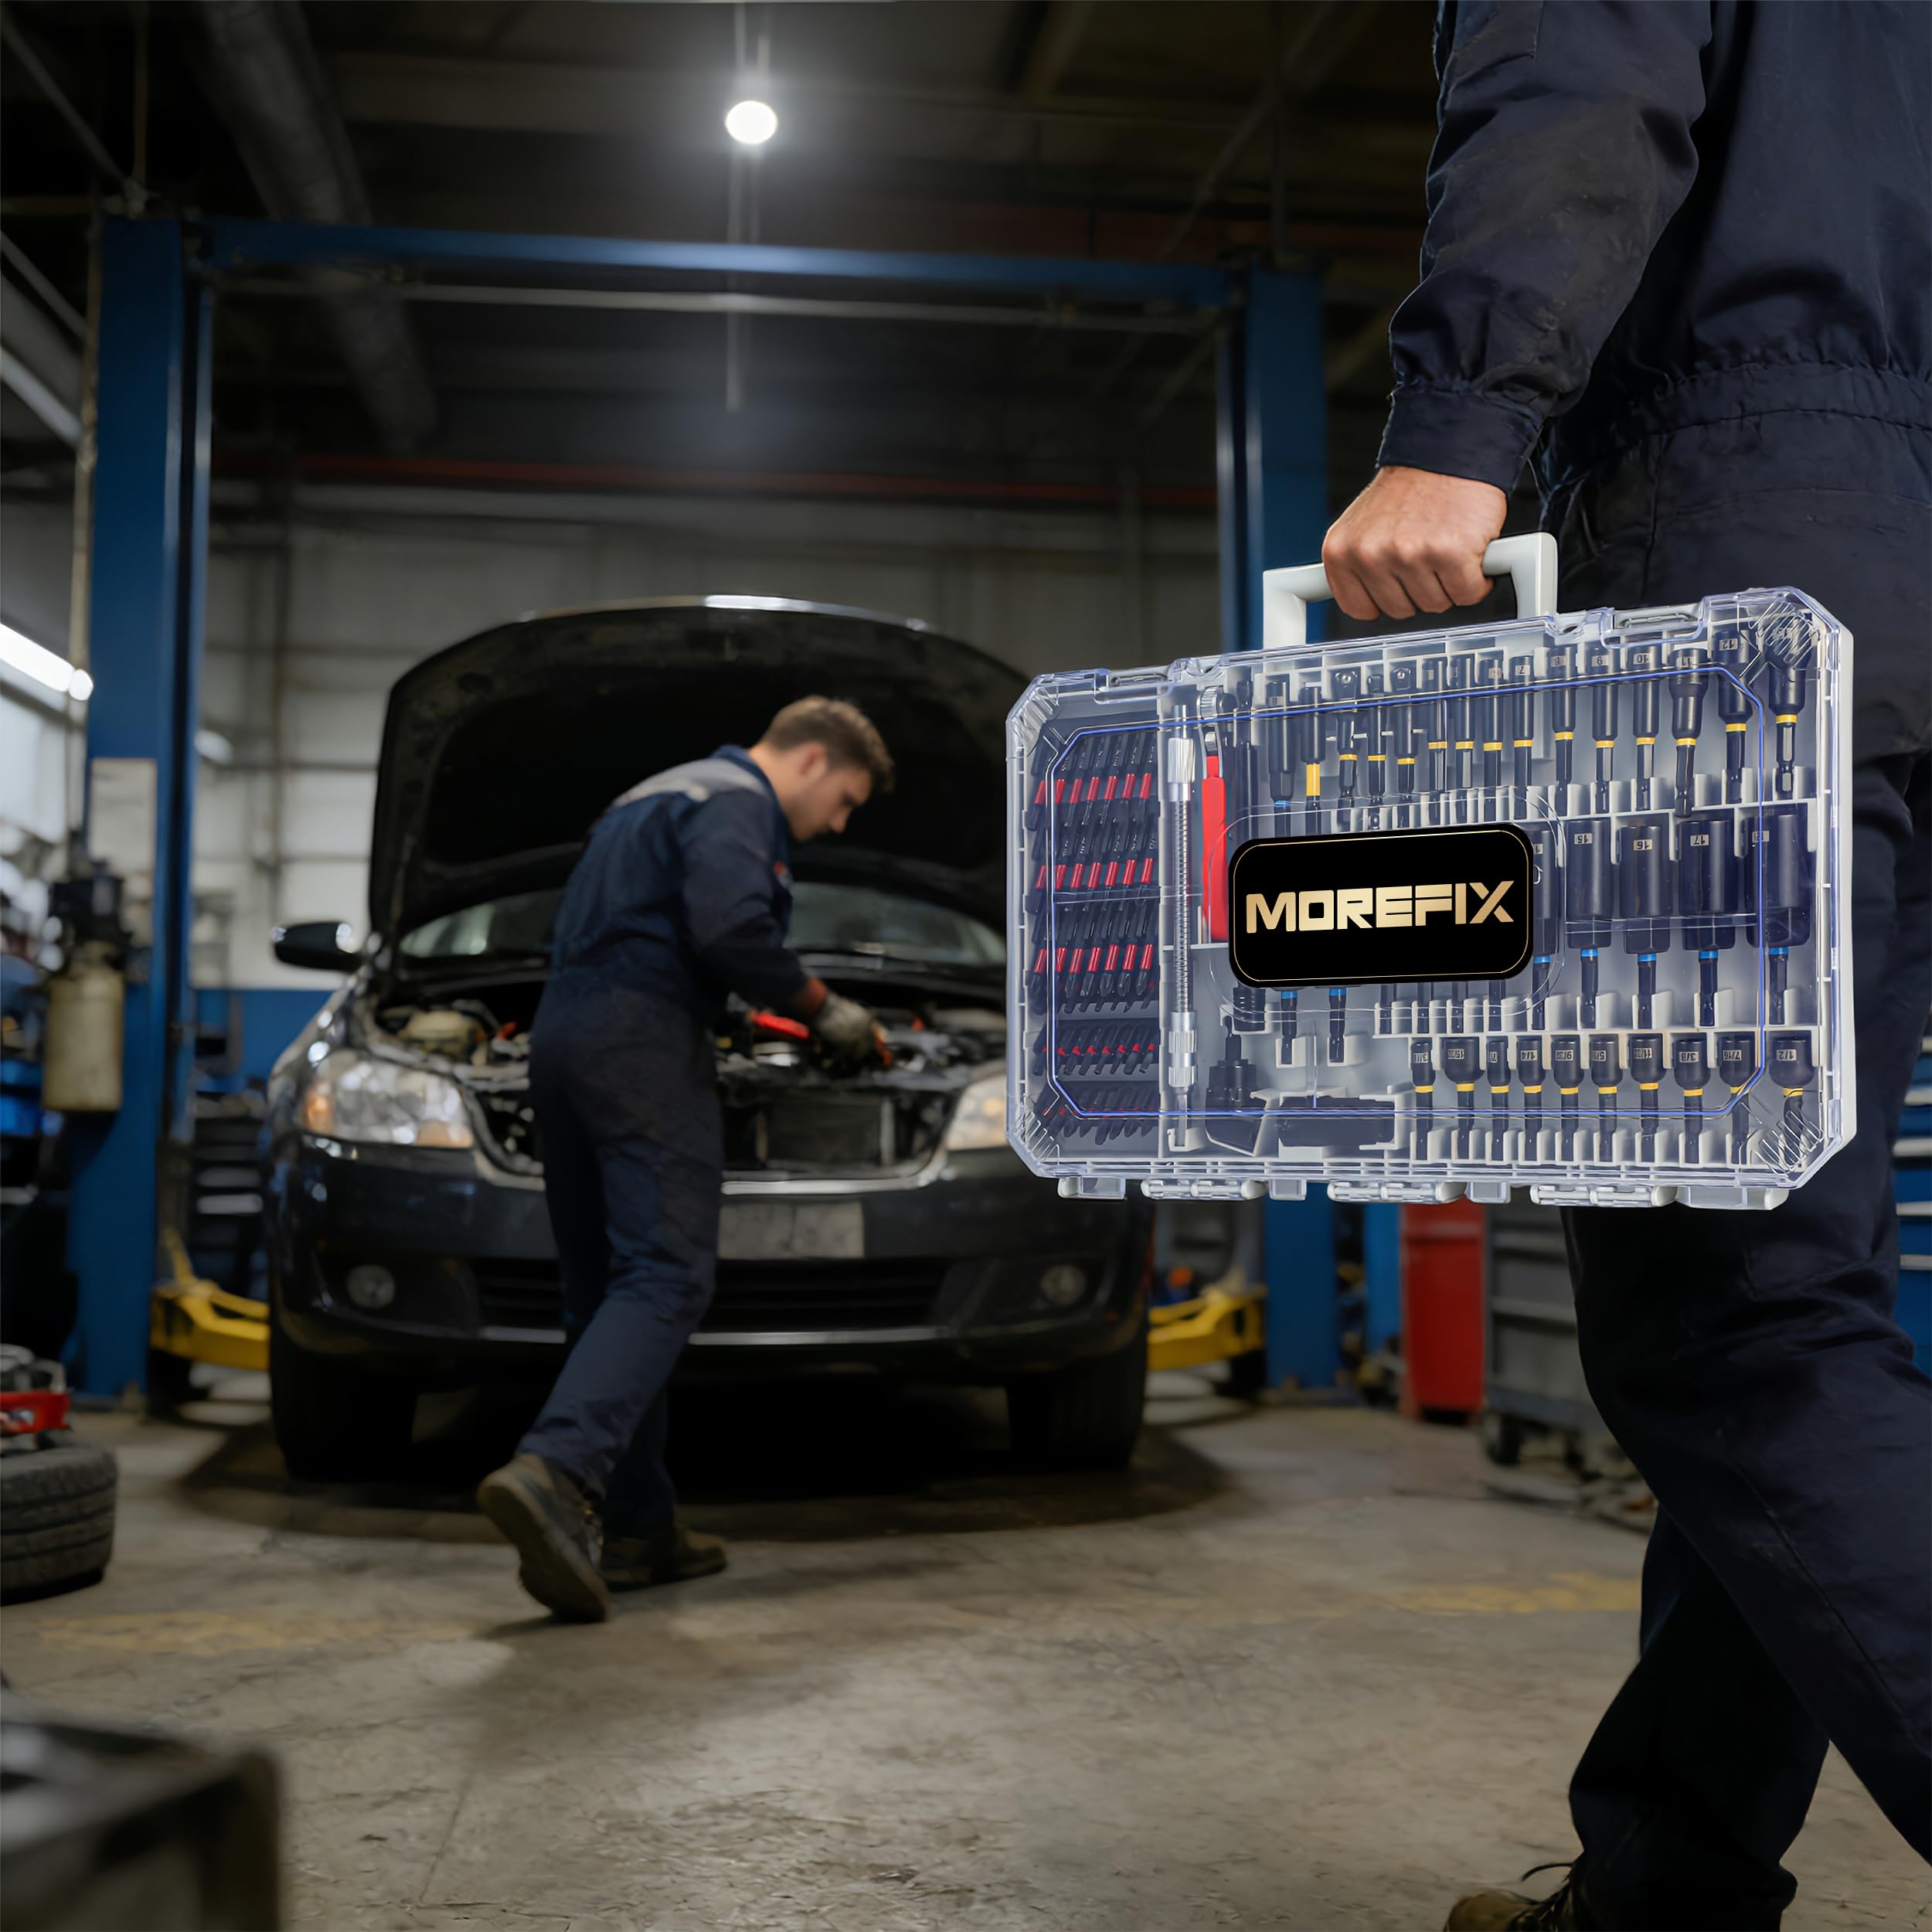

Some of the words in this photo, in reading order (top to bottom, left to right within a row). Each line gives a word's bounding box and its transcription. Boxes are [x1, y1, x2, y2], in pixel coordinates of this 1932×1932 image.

[1722, 638, 1735, 649] 12
[1636, 654, 1649, 664] 10
[1577, 835, 1589, 844] 15
[1693, 835, 1706, 845] 17
[1637, 841, 1649, 850] 16
[1246, 879, 1515, 934] MOREFIX
[1681, 1052, 1696, 1063] 3/8
[1723, 1050, 1741, 1060] 7/16
[1778, 1050, 1794, 1060] 1/2
